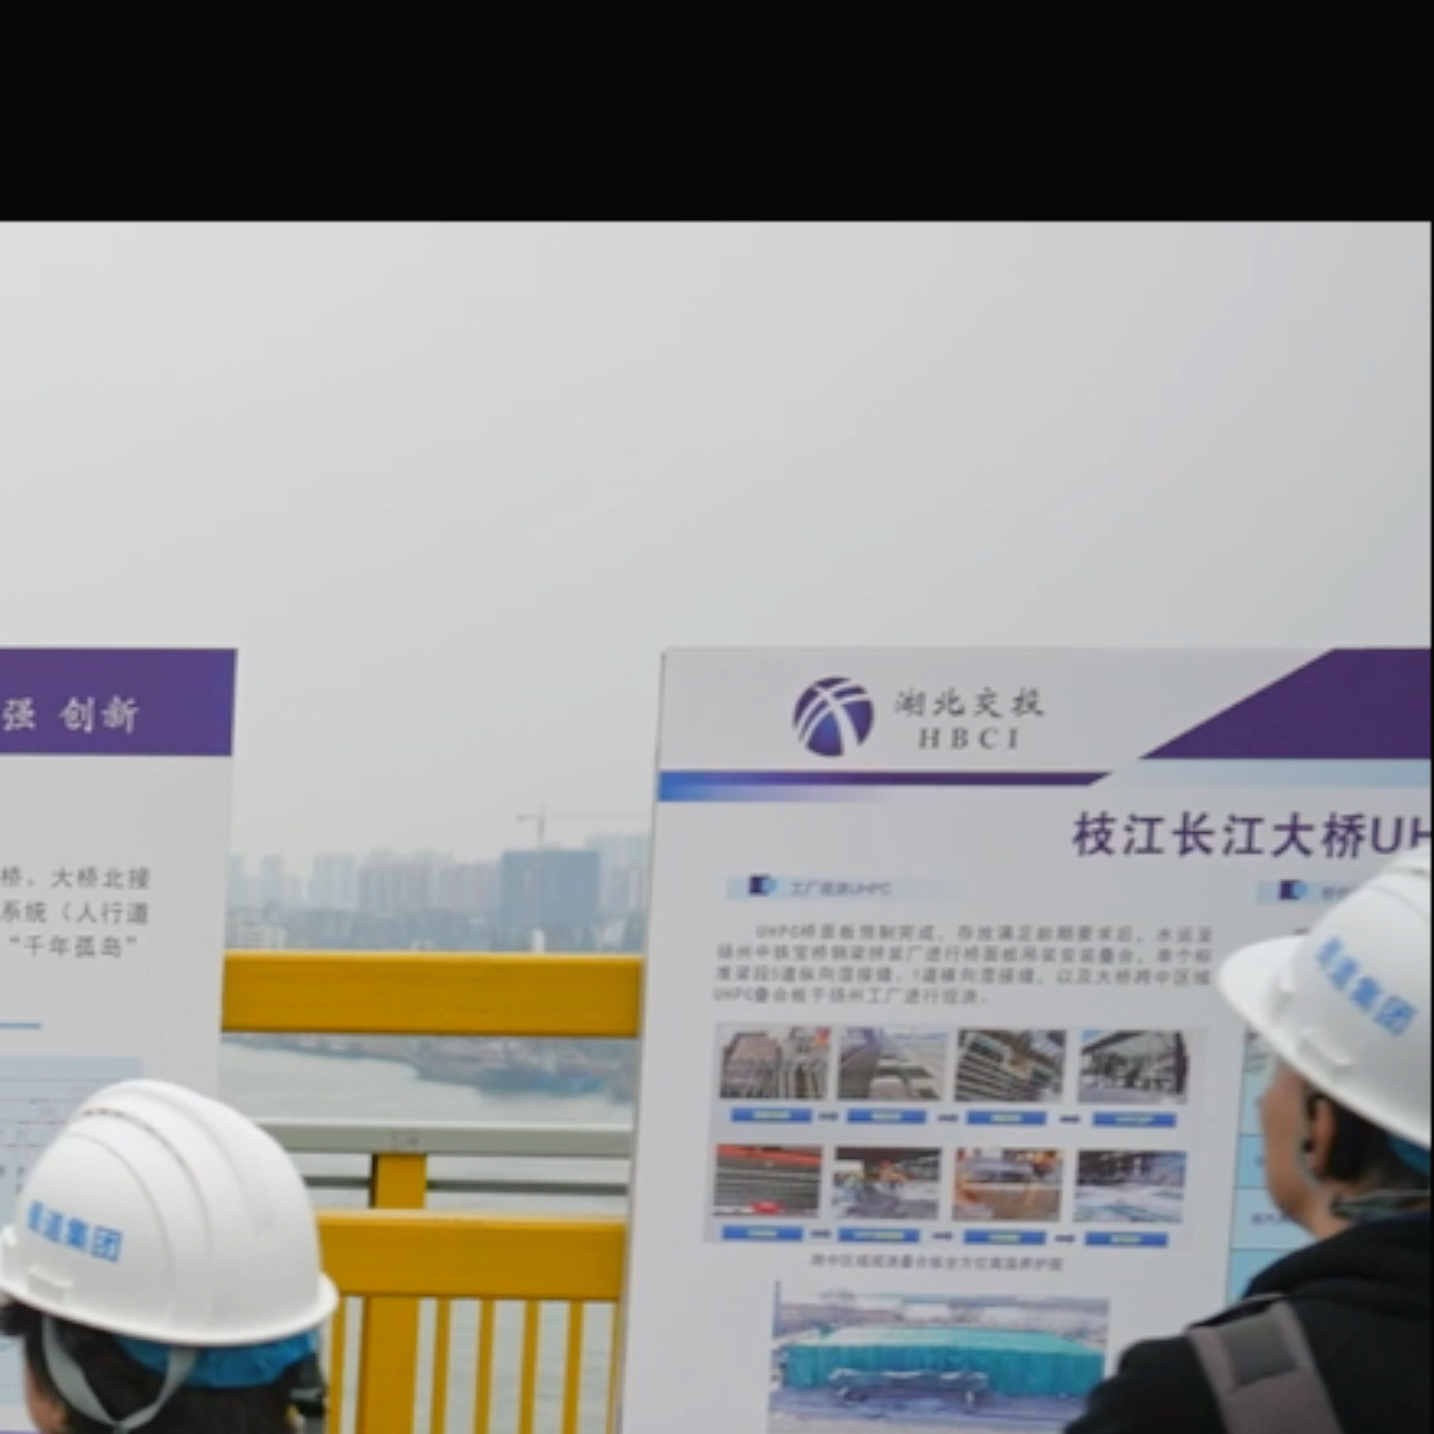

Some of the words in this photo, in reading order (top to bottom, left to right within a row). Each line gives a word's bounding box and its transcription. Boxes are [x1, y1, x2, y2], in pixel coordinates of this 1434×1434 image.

[60, 697, 140, 733] 创新
[895, 687, 1047, 719] 湖北交投
[919, 728, 1020, 750] HBCI
